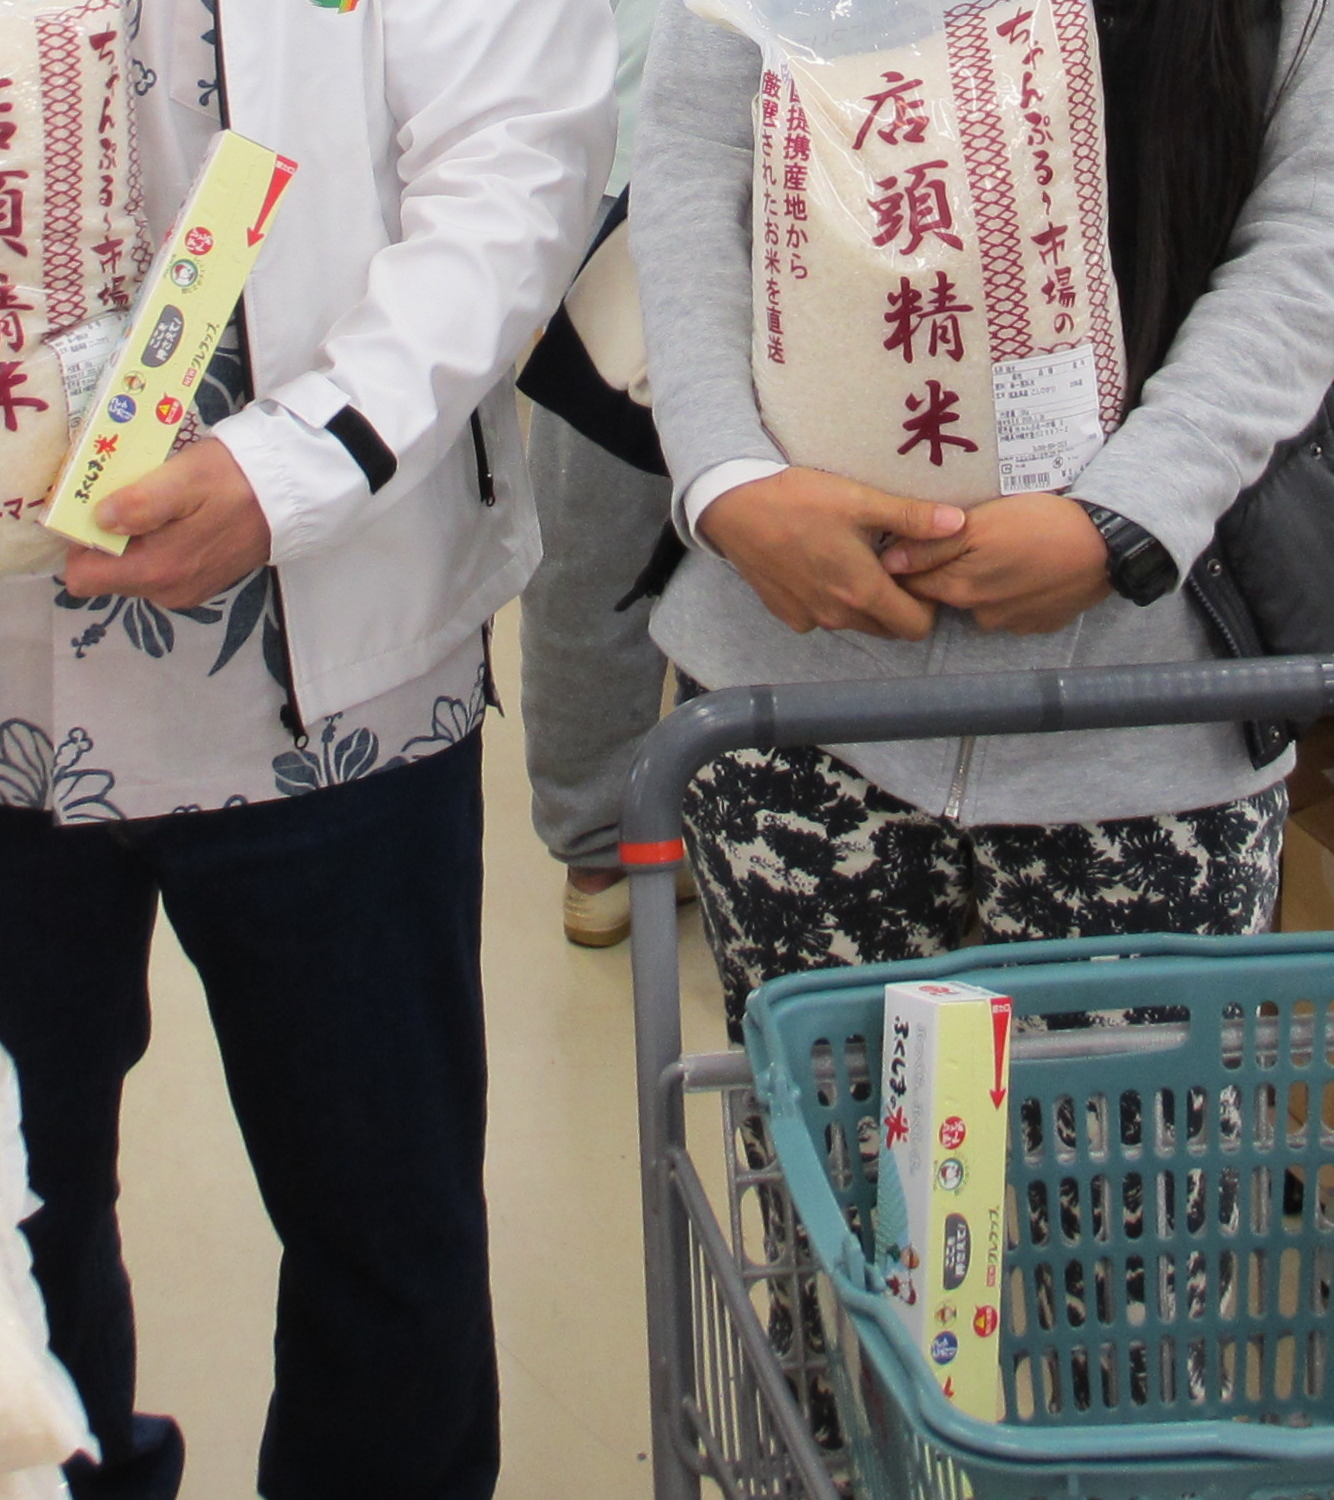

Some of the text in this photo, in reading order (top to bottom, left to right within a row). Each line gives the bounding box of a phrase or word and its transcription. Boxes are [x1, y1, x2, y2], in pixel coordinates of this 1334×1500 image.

[852, 70, 980, 466] 店頭精米
[883, 1013, 911, 1150] ふくしまの米
